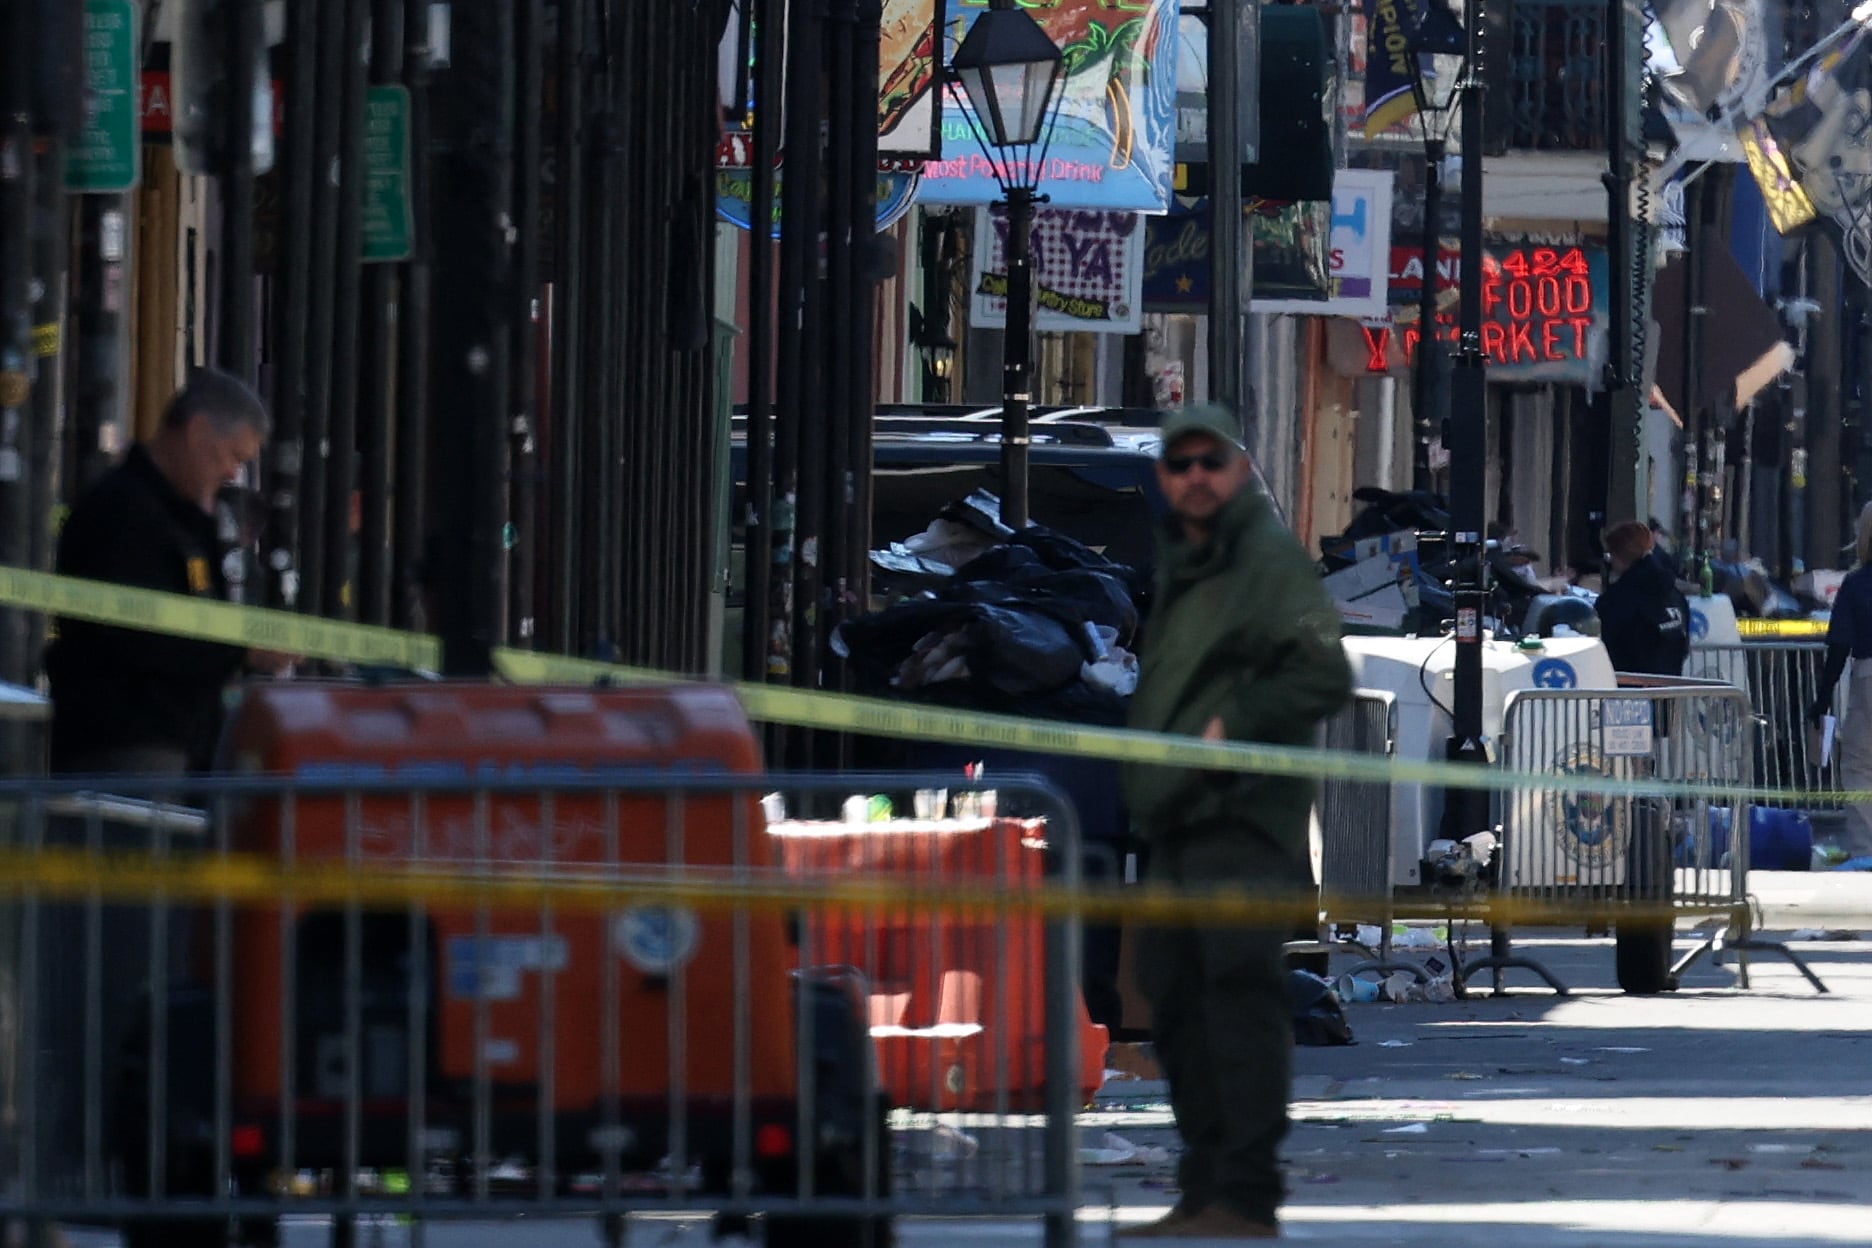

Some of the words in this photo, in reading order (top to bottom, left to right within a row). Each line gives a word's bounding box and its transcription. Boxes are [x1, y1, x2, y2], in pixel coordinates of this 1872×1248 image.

[1050, 157, 1105, 182] Drink
[1060, 232, 1114, 285] YA
[1484, 274, 1593, 319] FOOD
